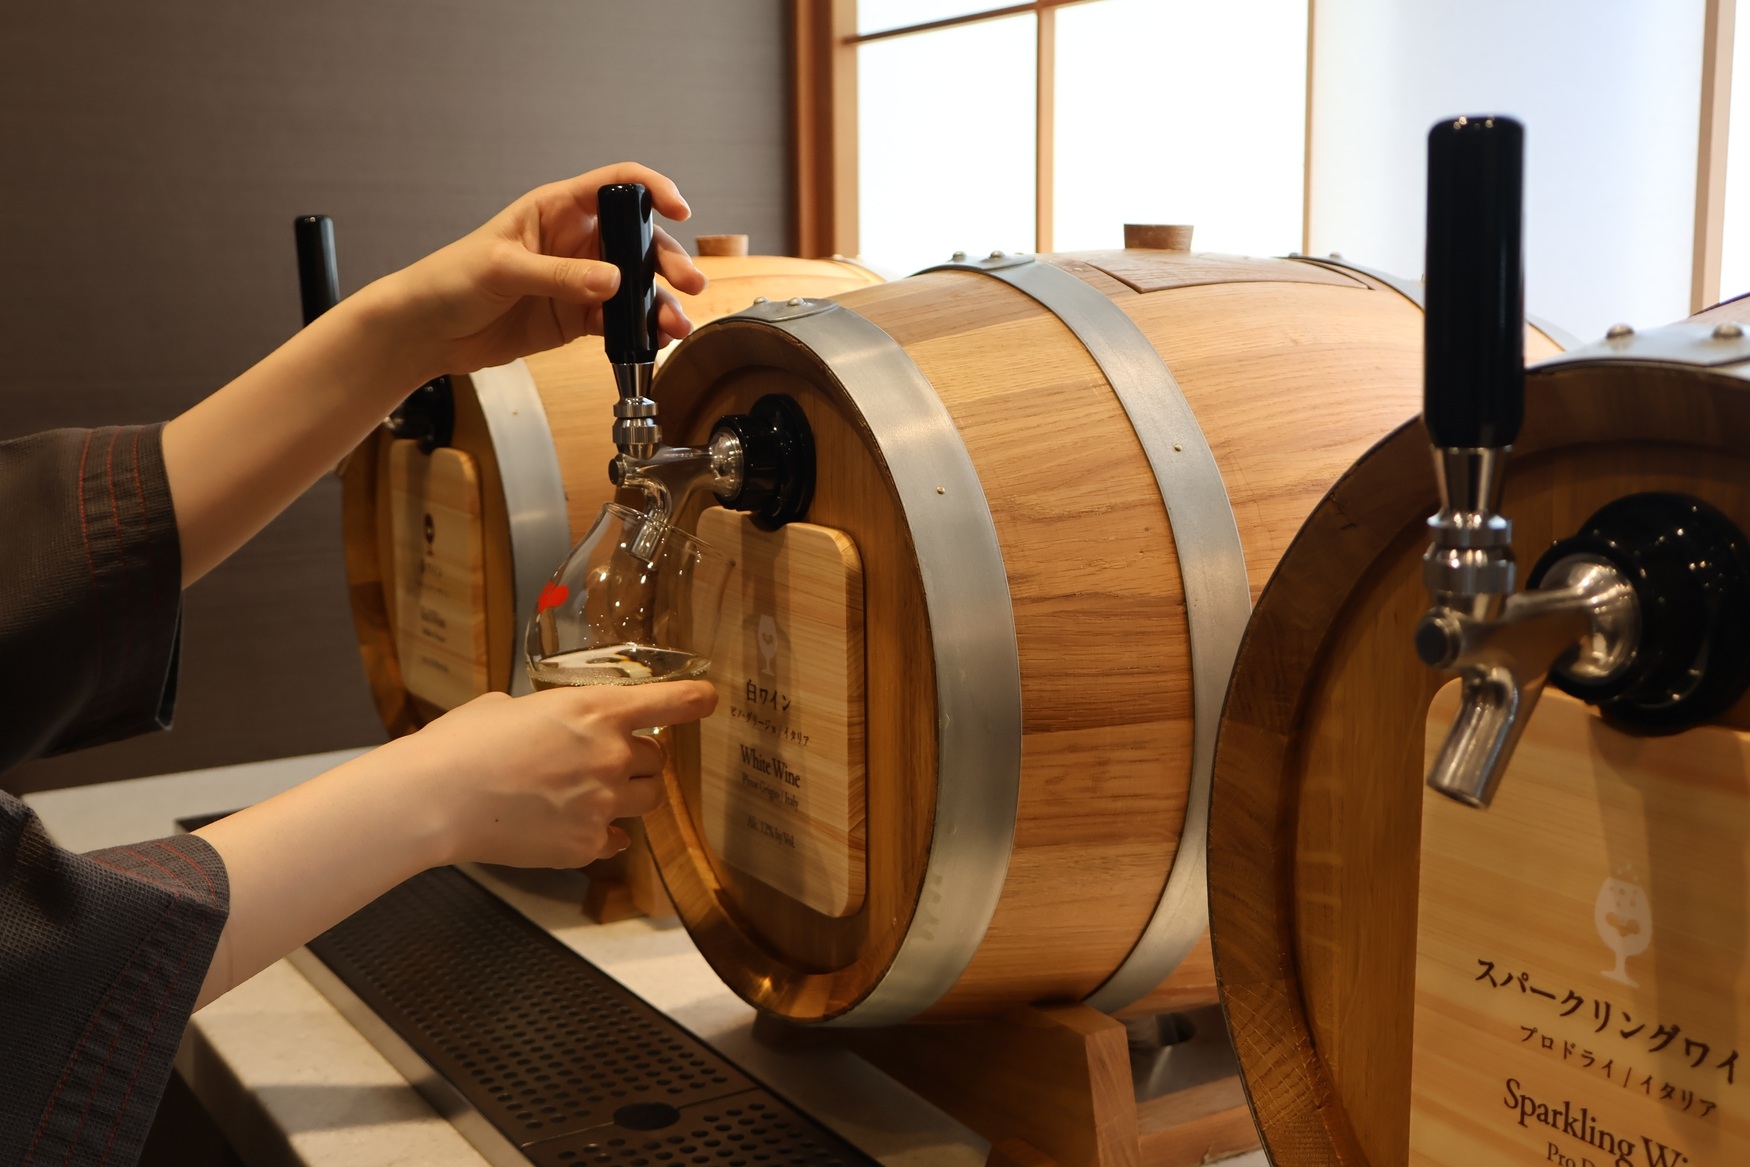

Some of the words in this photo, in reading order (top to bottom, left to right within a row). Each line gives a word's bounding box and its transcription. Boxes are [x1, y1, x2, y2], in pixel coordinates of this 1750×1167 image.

[746, 678, 792, 712] 白ワイン
[784, 727, 810, 747] イタリア
[740, 743, 771, 775] White
[772, 757, 801, 788] Wine
[784, 791, 799, 813] Italy
[1520, 1024, 1614, 1079] プロドライ
[1640, 1075, 1717, 1118] イタリア
[1503, 1077, 1636, 1167] Sparkling
